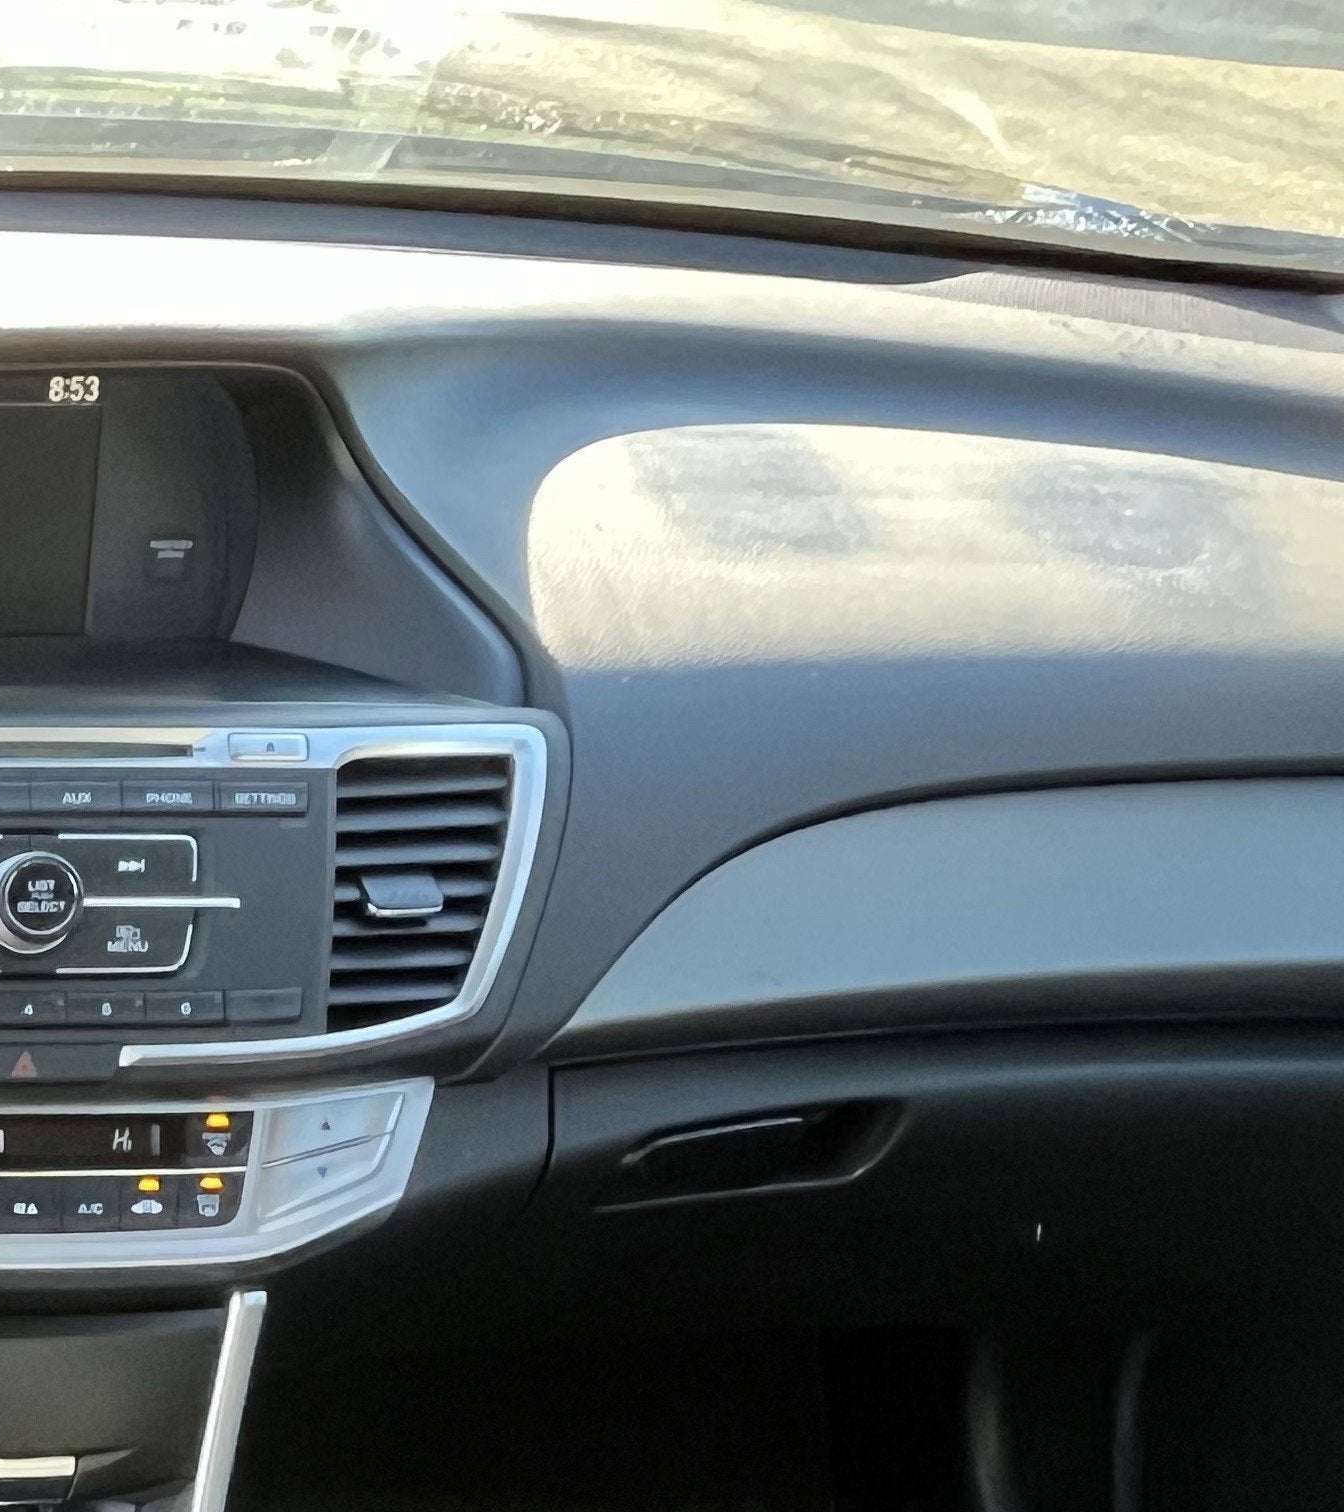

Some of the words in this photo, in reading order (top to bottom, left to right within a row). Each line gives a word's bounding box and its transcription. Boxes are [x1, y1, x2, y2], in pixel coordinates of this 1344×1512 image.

[49, 375, 100, 402] 8:53
[62, 792, 92, 805] AUX
[22, 1004, 34, 1016] 4
